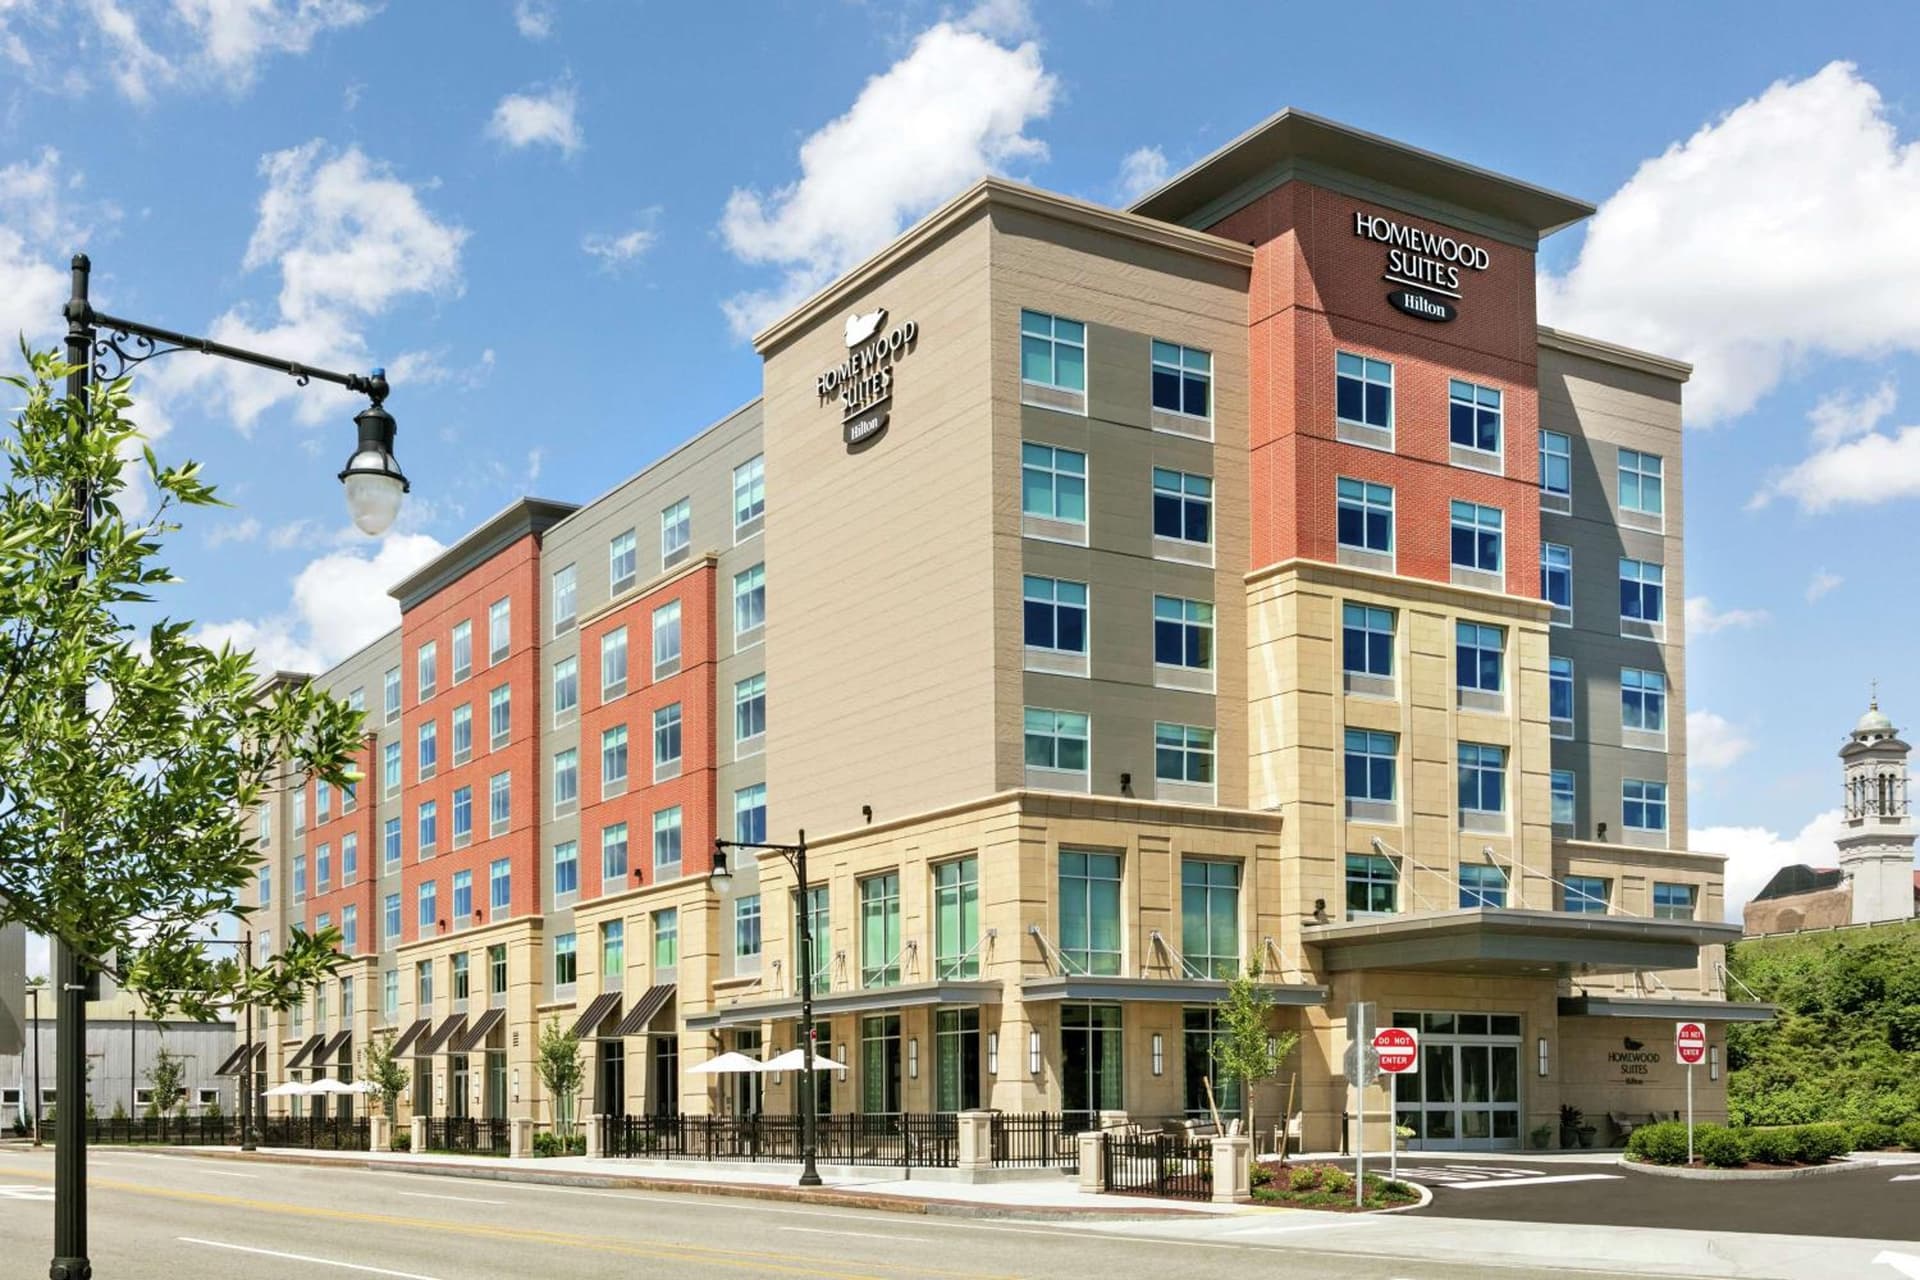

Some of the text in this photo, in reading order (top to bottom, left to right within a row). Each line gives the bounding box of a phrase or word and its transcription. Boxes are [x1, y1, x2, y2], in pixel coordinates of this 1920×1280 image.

[1356, 212, 1489, 270] HOMEWOOD
[1389, 249, 1459, 289] SUITES
[1404, 293, 1445, 317] Hilton
[816, 320, 914, 395] HOMEWOOD
[840, 365, 890, 411] SUITES
[851, 417, 878, 440] Hilton
[1378, 1036, 1410, 1045] DO NOT
[1381, 1056, 1407, 1065] ENTER
[1608, 1051, 1660, 1063] HOMEWOOD
[1620, 1064, 1648, 1075] SUITES
